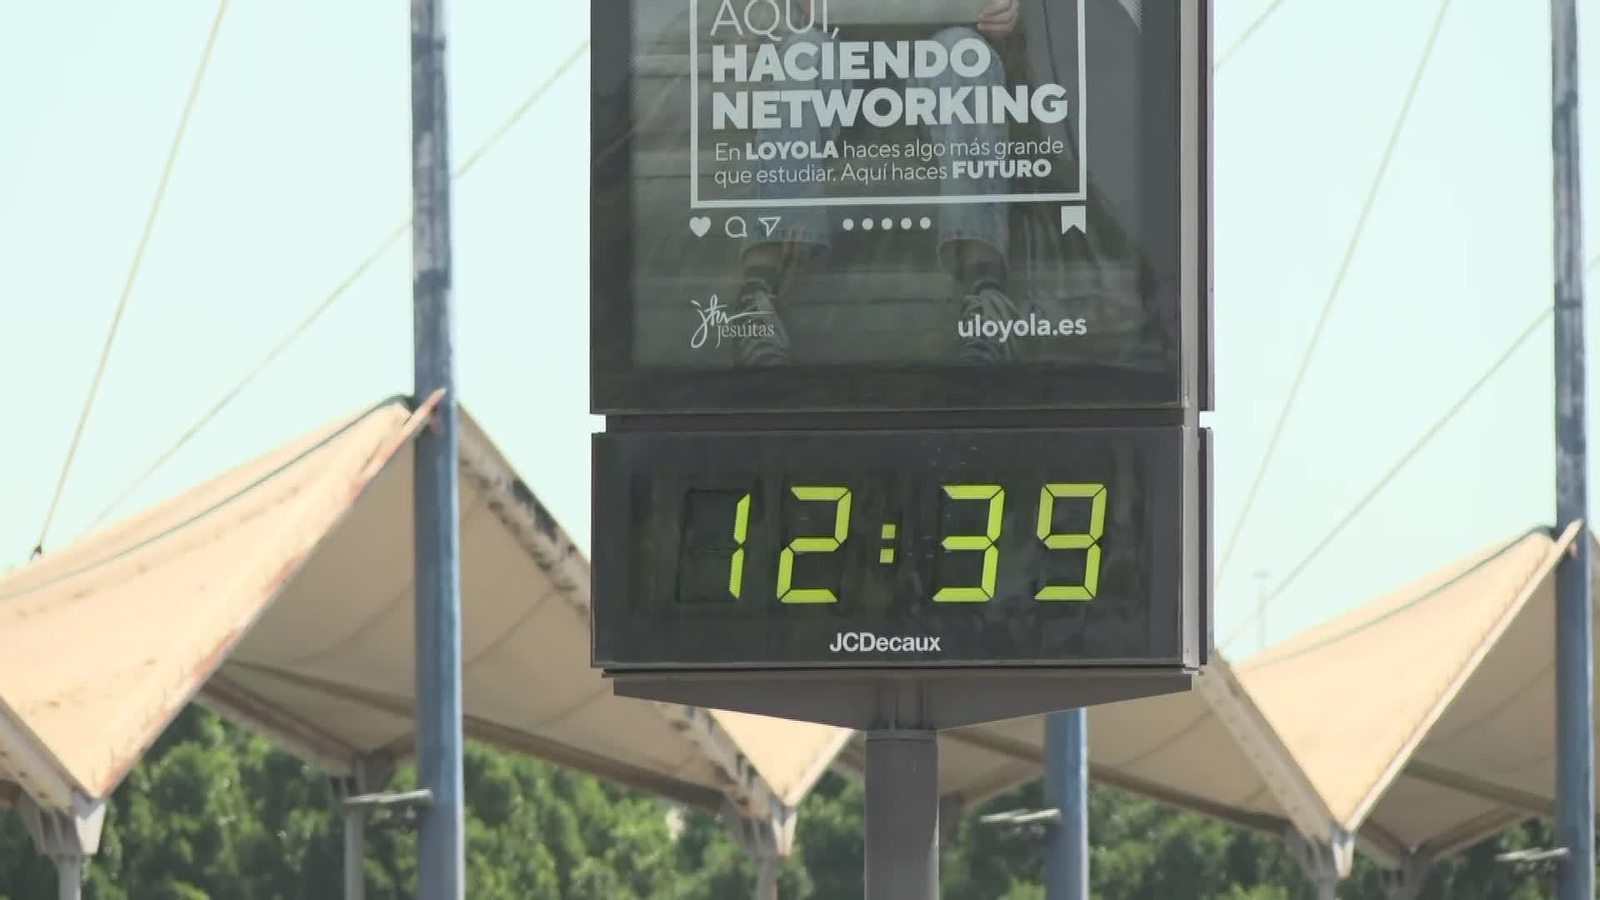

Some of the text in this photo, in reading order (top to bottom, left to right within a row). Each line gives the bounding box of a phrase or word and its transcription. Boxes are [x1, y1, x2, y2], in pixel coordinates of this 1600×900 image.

[712, 39, 991, 83] HACIENDO
[712, 84, 1069, 130] NETWORKING
[715, 136, 1064, 164] En LOYOLA haces algo más grande
[714, 158, 1052, 189] que estudiar. Aquí haces FUTURO
[957, 313, 1088, 343] uloyola.es
[729, 483, 1108, 604] 12:39
[829, 632, 942, 654] JCDecaux
